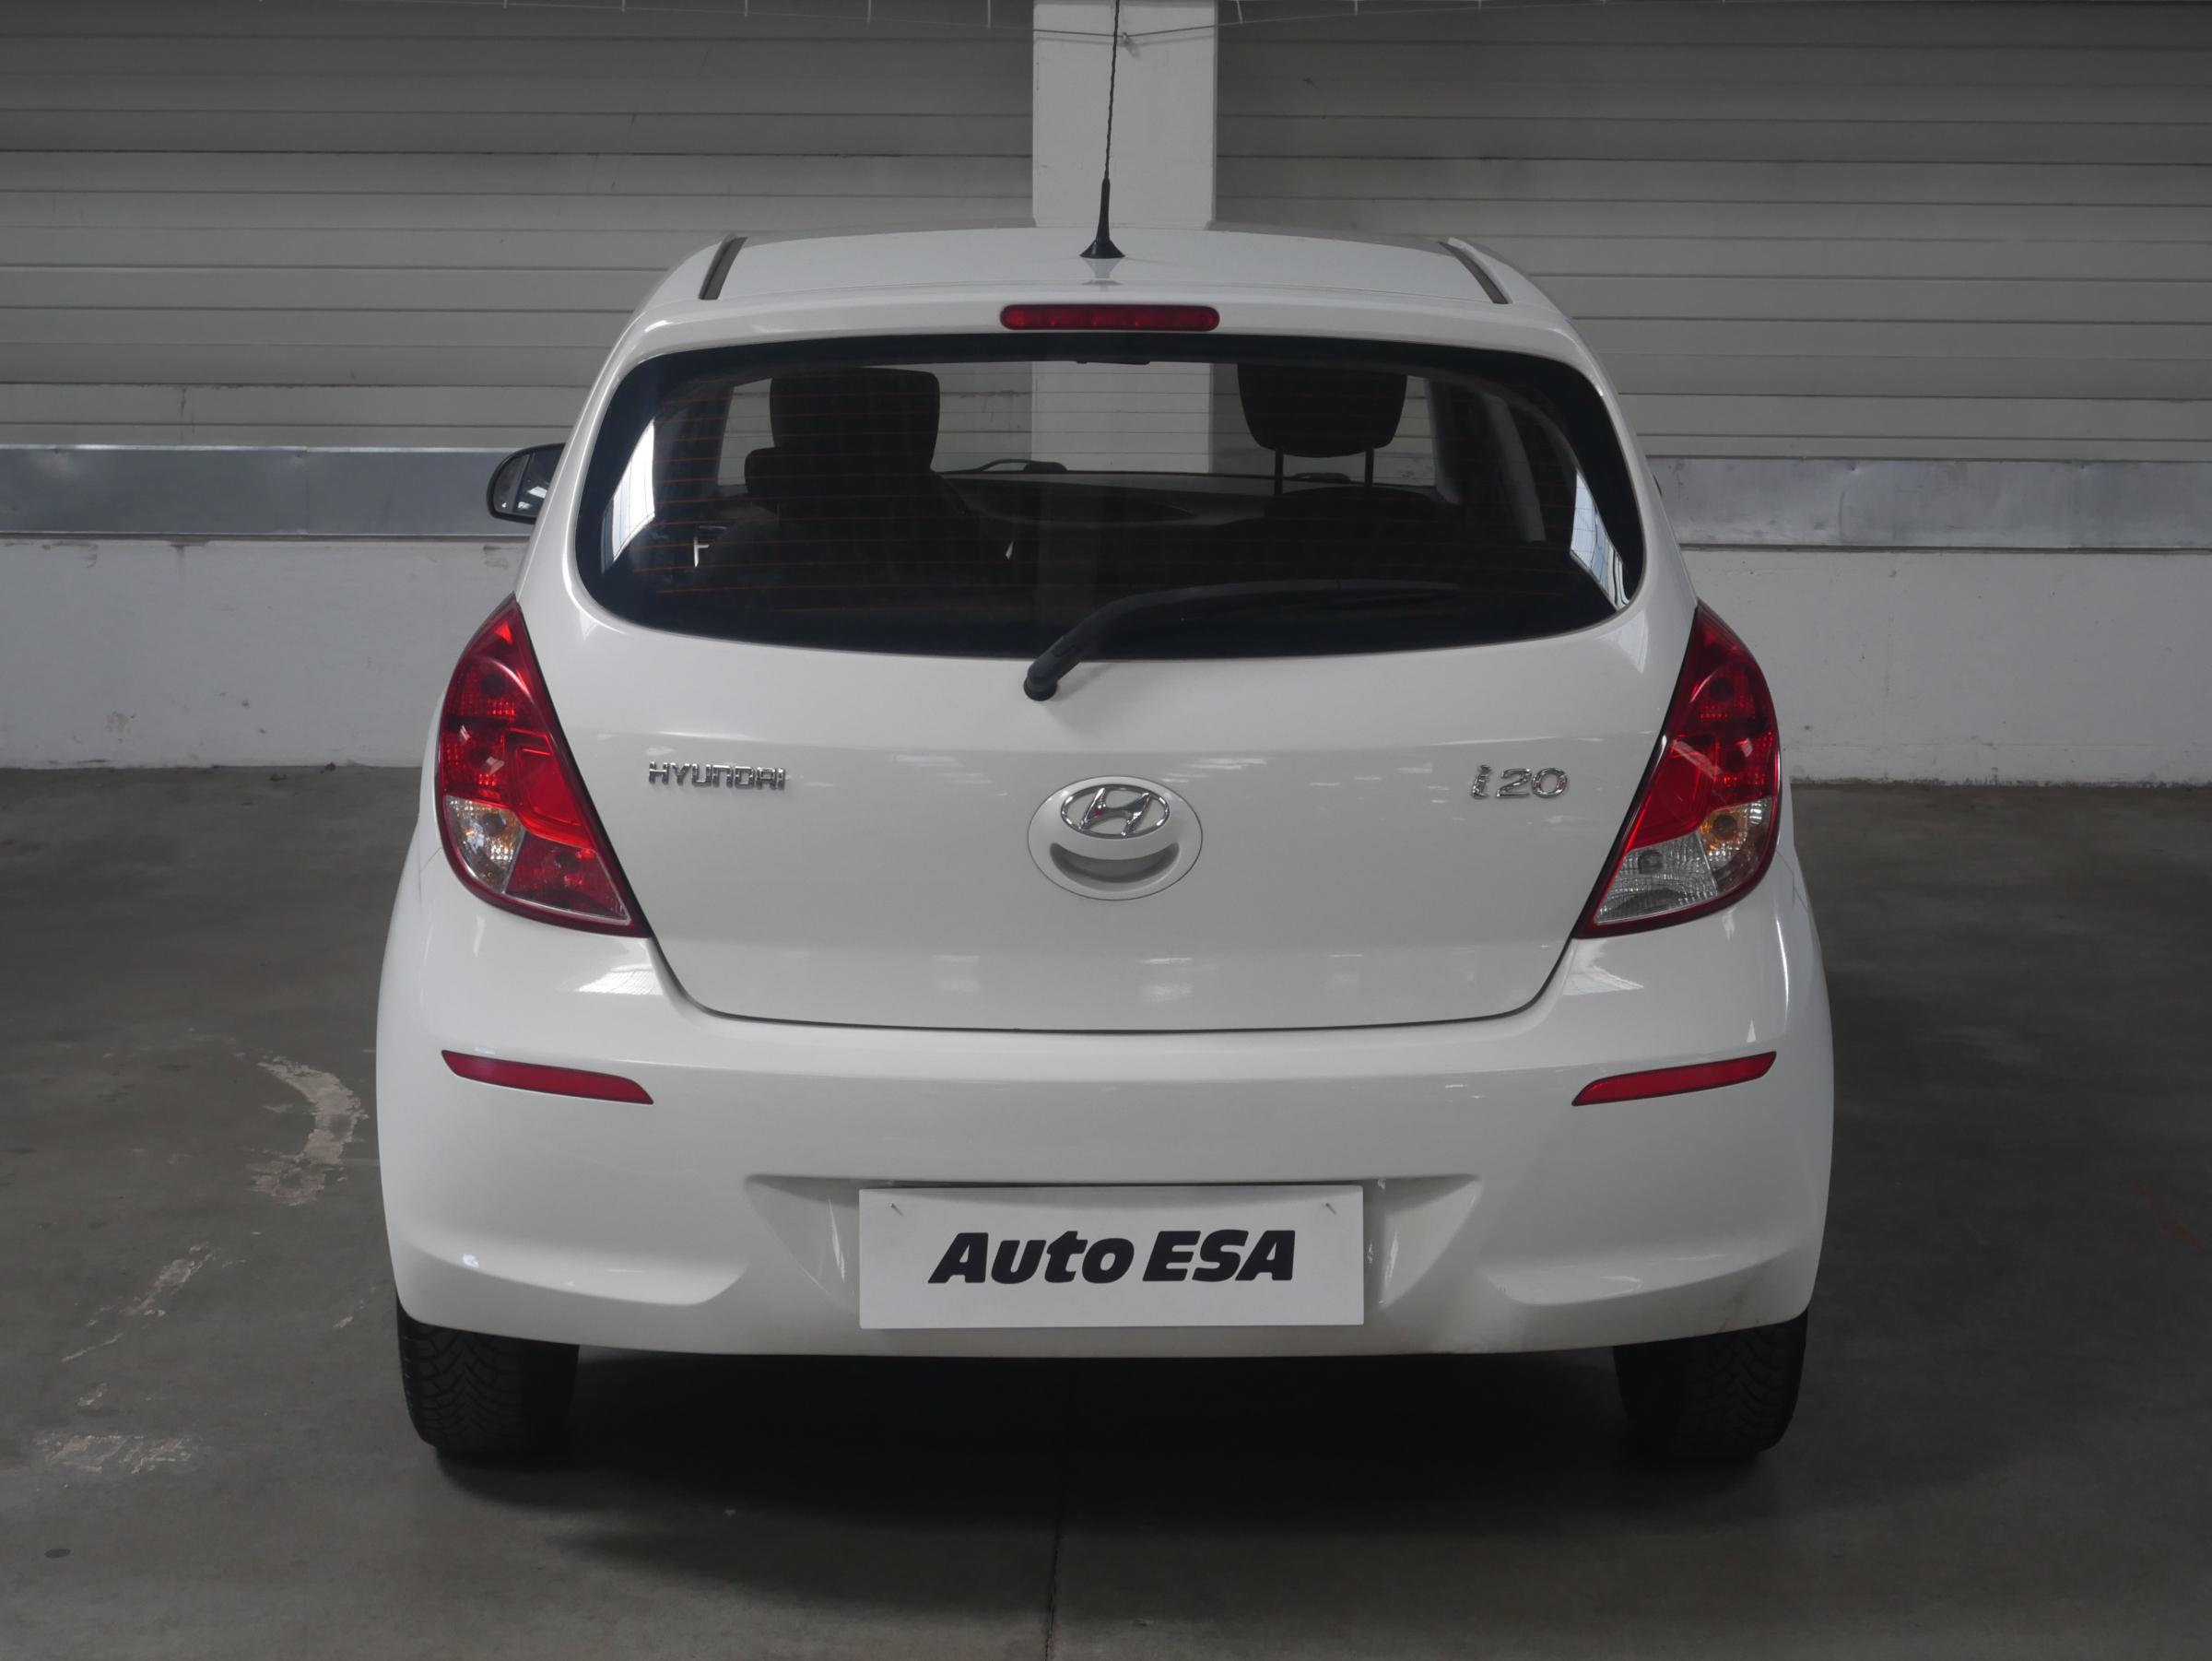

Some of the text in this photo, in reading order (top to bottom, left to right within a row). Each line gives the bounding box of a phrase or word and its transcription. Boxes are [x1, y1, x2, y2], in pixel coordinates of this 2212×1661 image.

[648, 760, 785, 790] HYUNDAI
[927, 1229, 1296, 1285] Auto ESA
